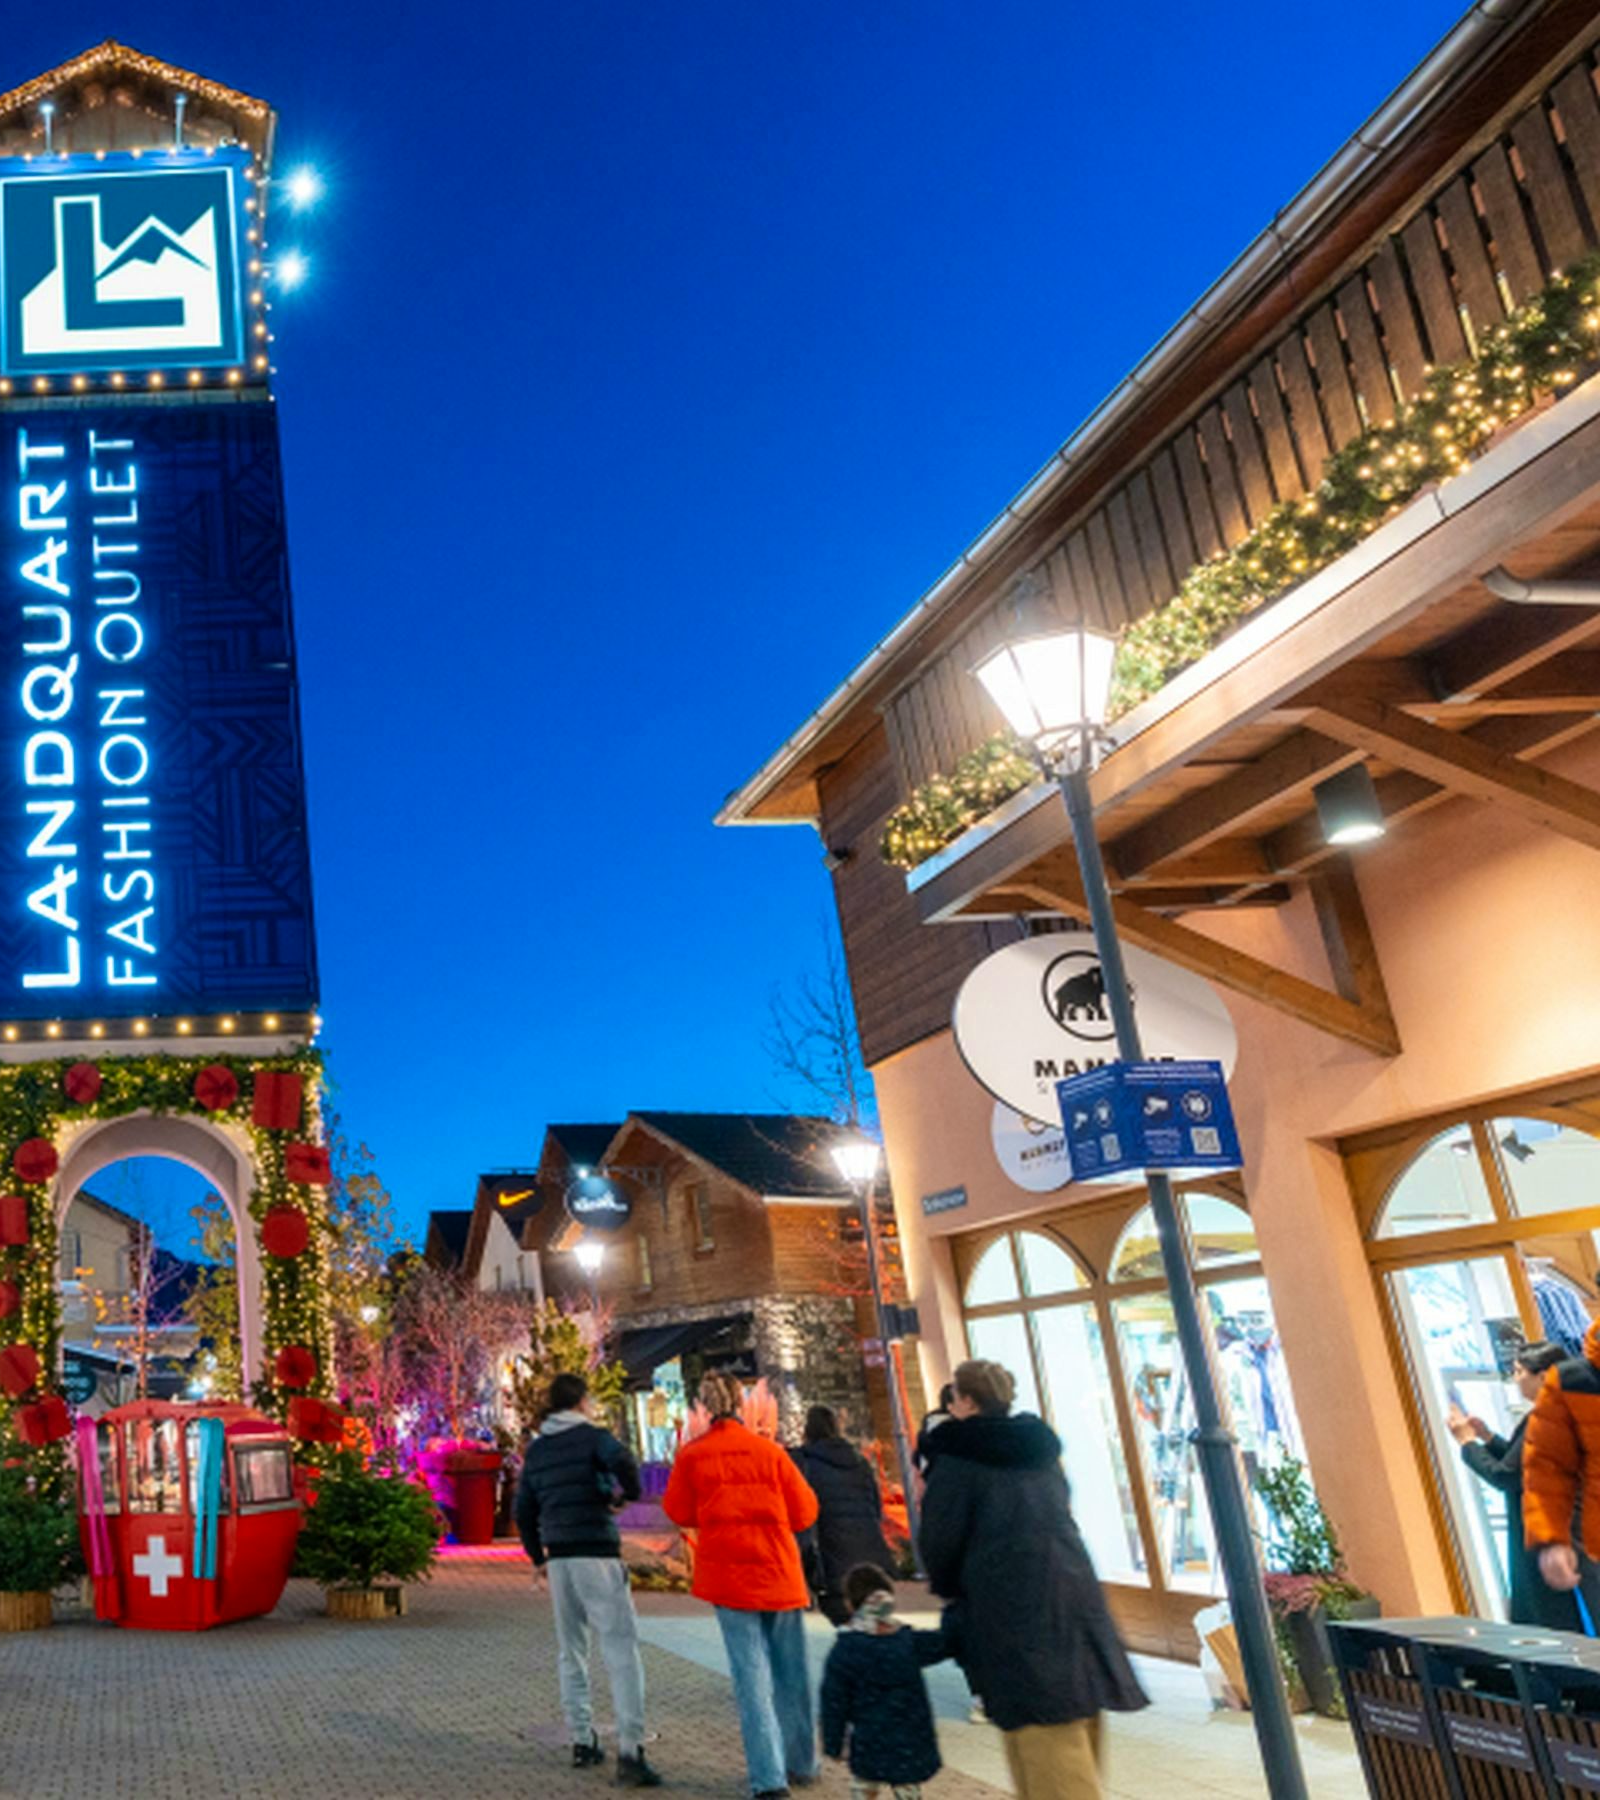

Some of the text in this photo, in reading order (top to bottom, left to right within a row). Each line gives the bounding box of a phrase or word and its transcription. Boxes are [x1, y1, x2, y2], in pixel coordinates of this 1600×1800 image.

[18, 427, 81, 988] LANDQUART
[89, 430, 158, 987] FASHION OUTLET
